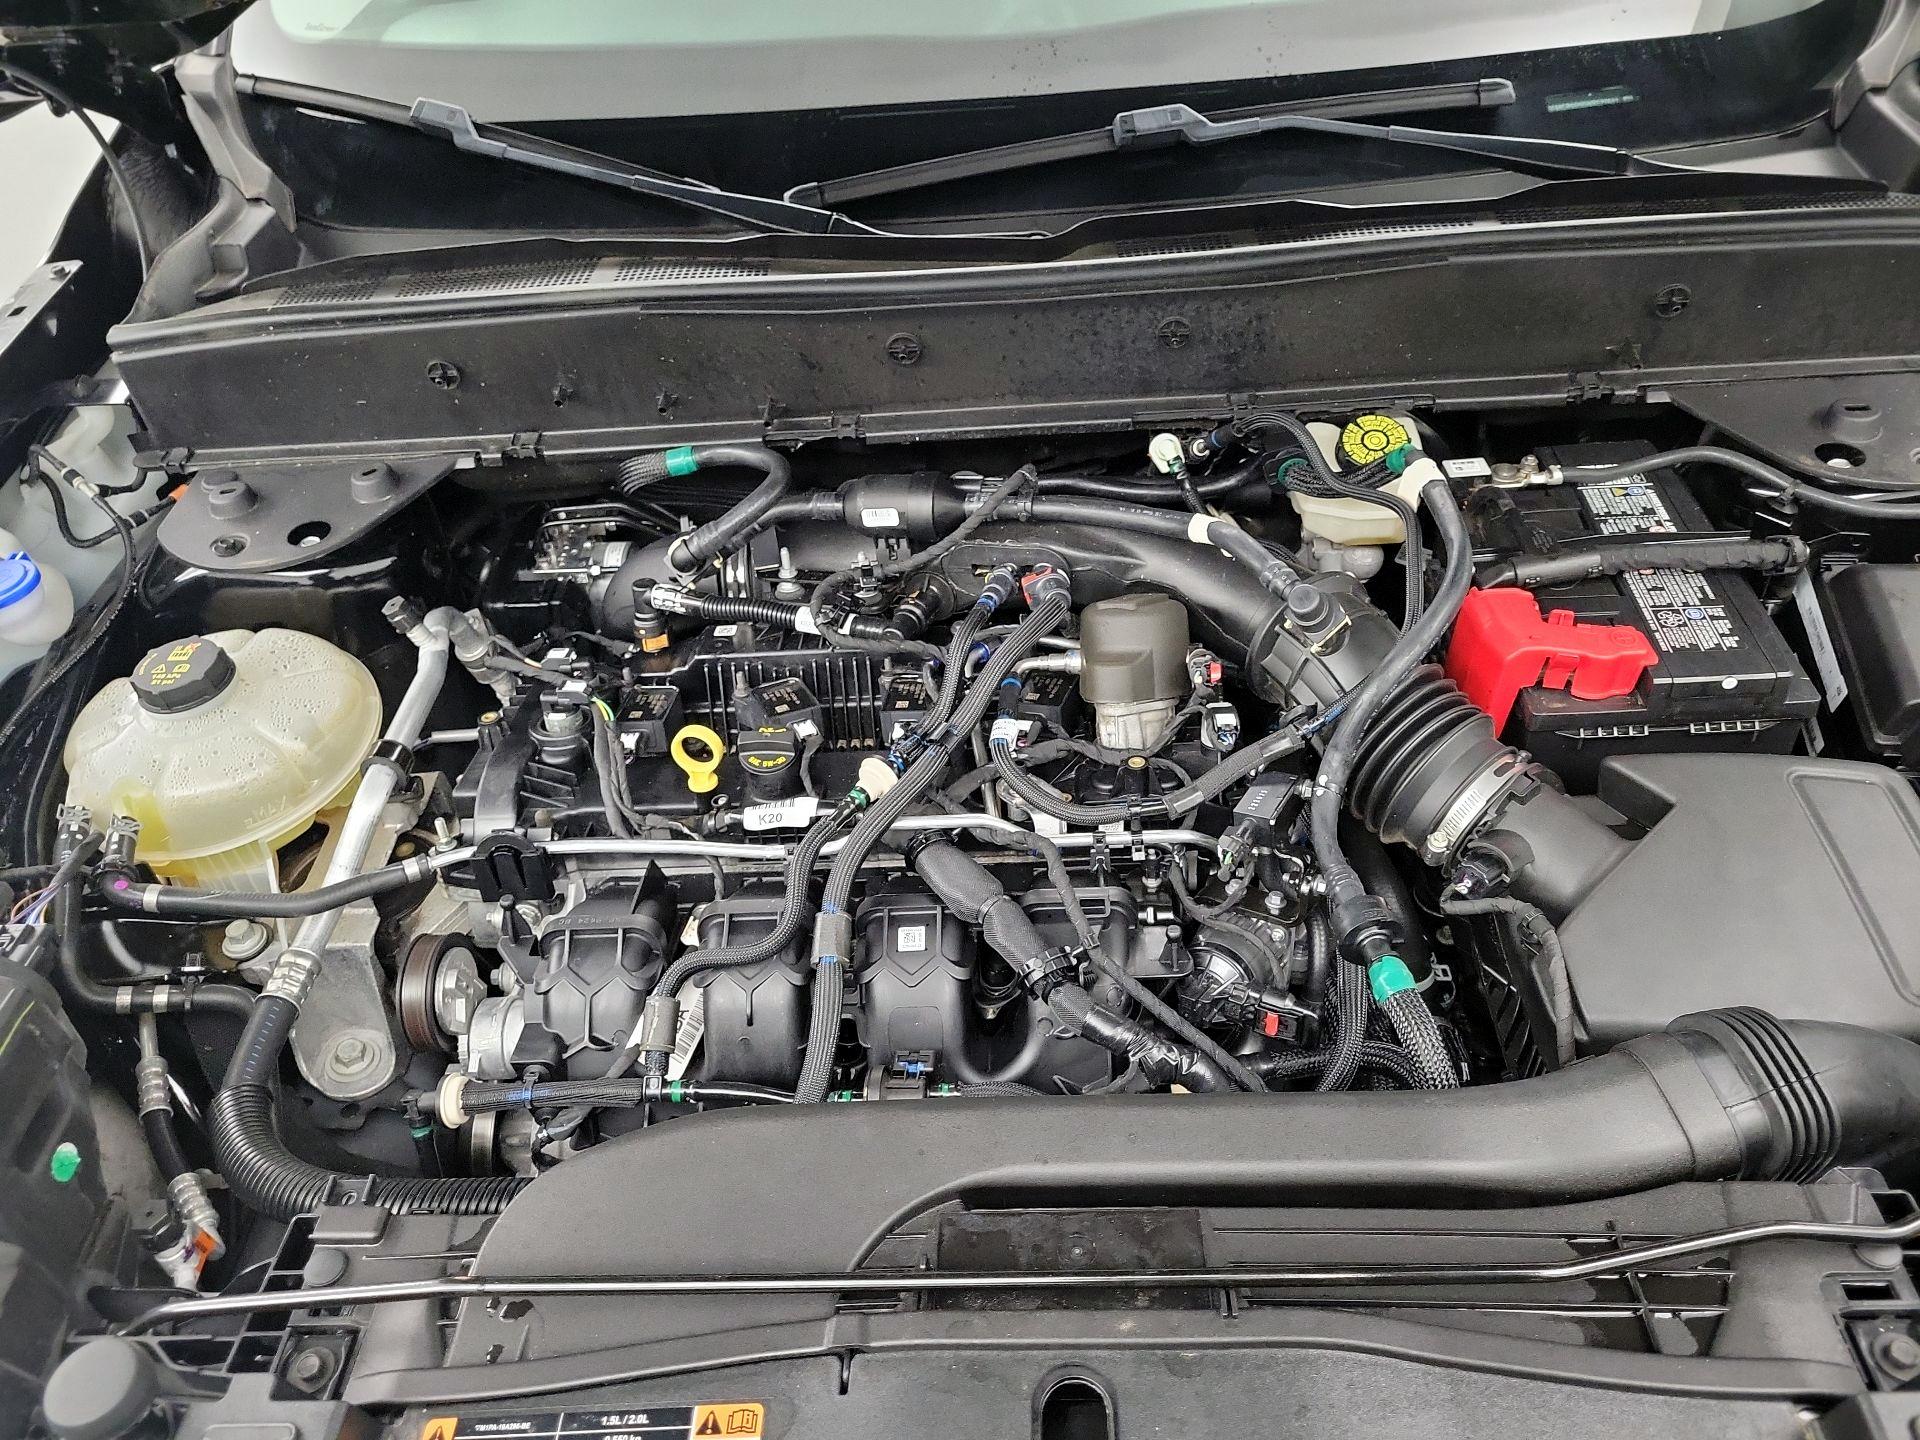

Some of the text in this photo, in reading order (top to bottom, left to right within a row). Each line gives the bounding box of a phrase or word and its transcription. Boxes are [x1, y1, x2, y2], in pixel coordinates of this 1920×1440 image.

[758, 813, 783, 825] K20
[601, 1415, 622, 1426] 1.5L
[628, 1413, 650, 1425] 2.0L
